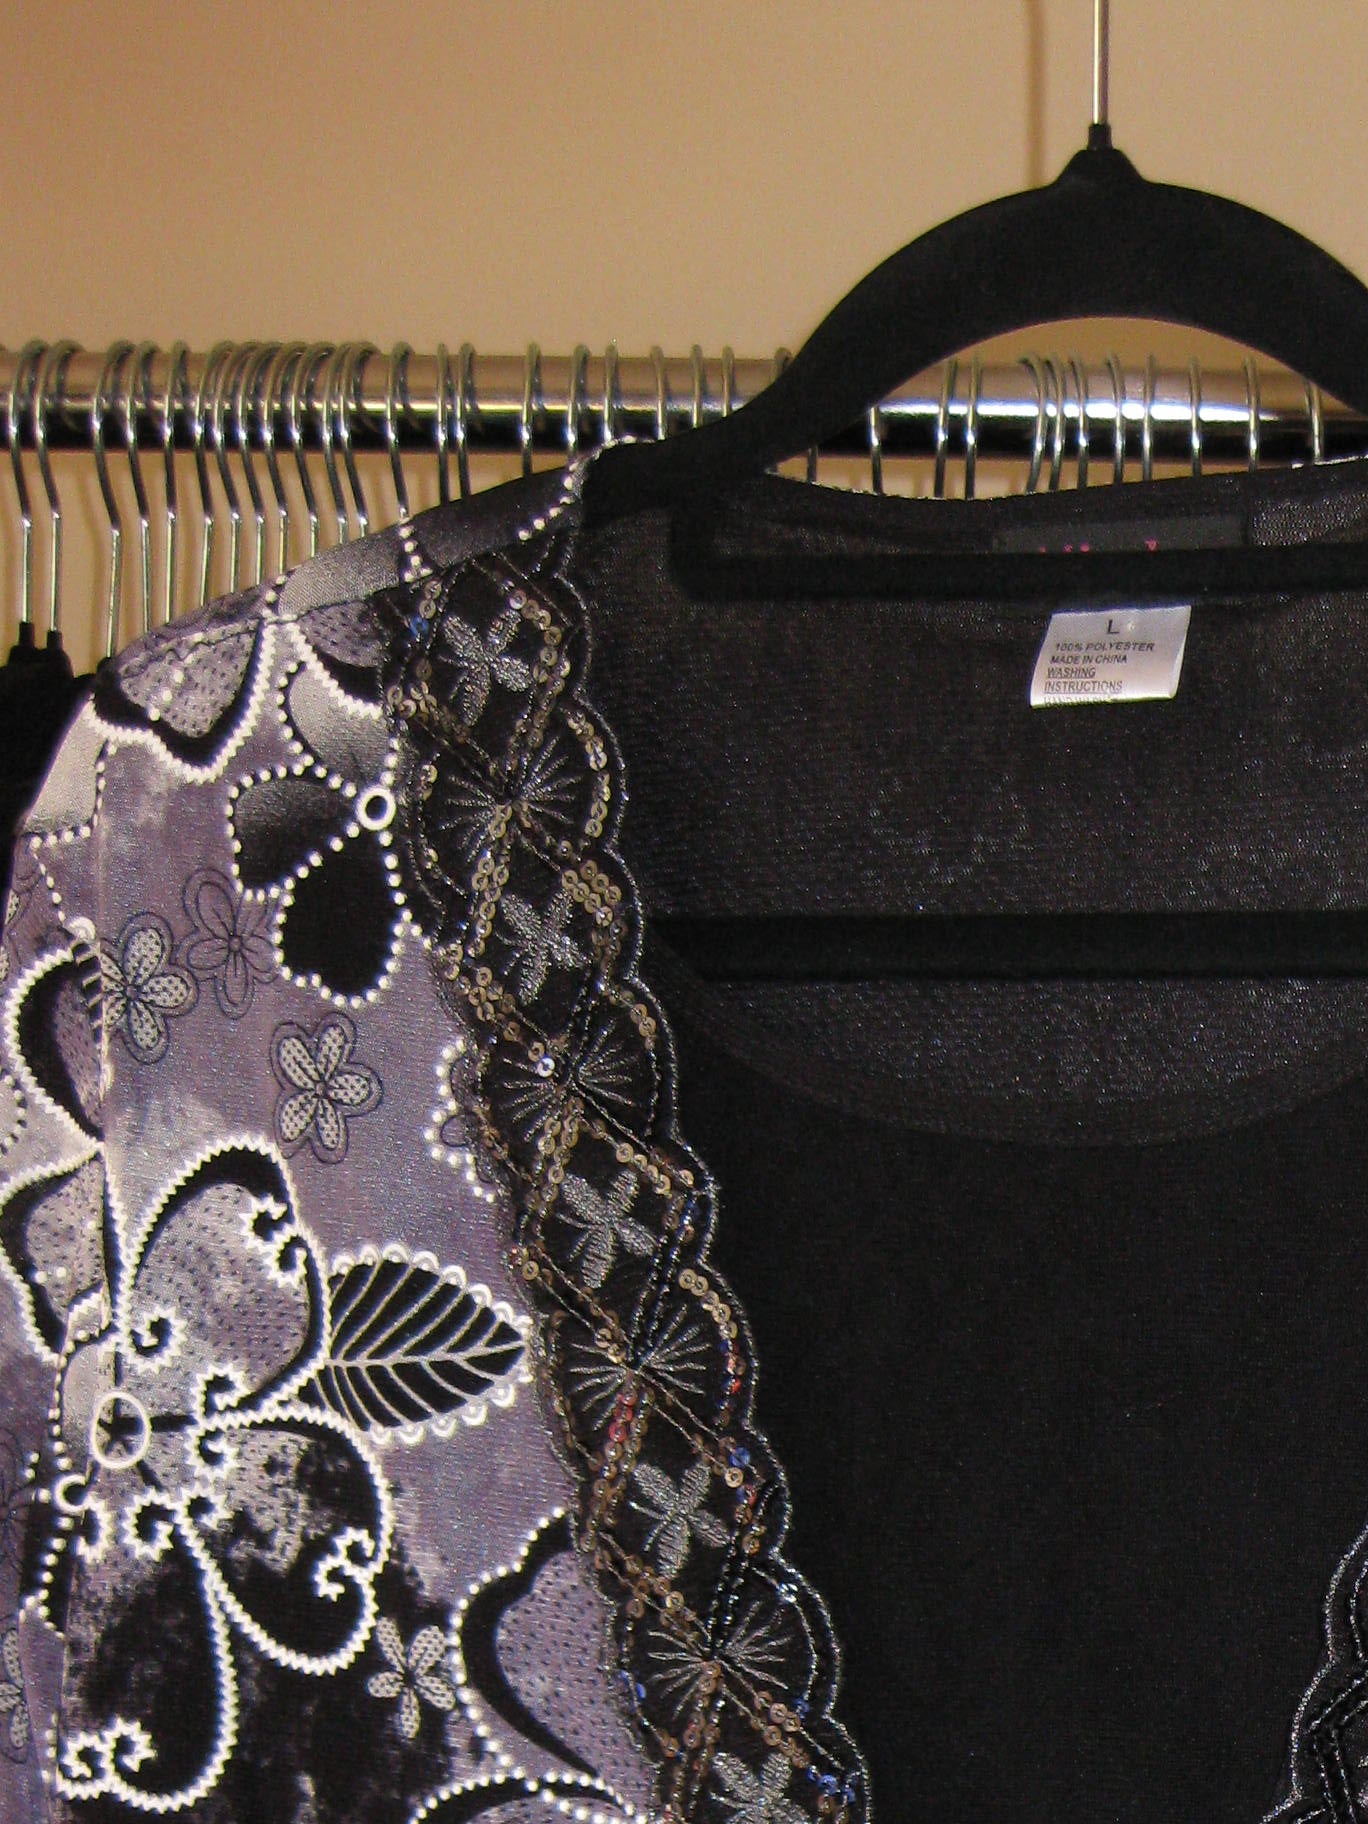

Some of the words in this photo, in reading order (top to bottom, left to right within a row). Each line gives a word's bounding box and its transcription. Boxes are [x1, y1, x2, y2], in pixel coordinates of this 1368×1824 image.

[1107, 619, 1119, 634] L
[1056, 642, 1082, 651] 100%
[1087, 641, 1155, 651] POLYESTER
[1050, 655, 1079, 665] MADE
[1082, 655, 1093, 664] IN
[1095, 654, 1128, 664] CHINA
[1047, 667, 1095, 678] WASHING
[1044, 680, 1123, 692] INSTRUCTIONS
